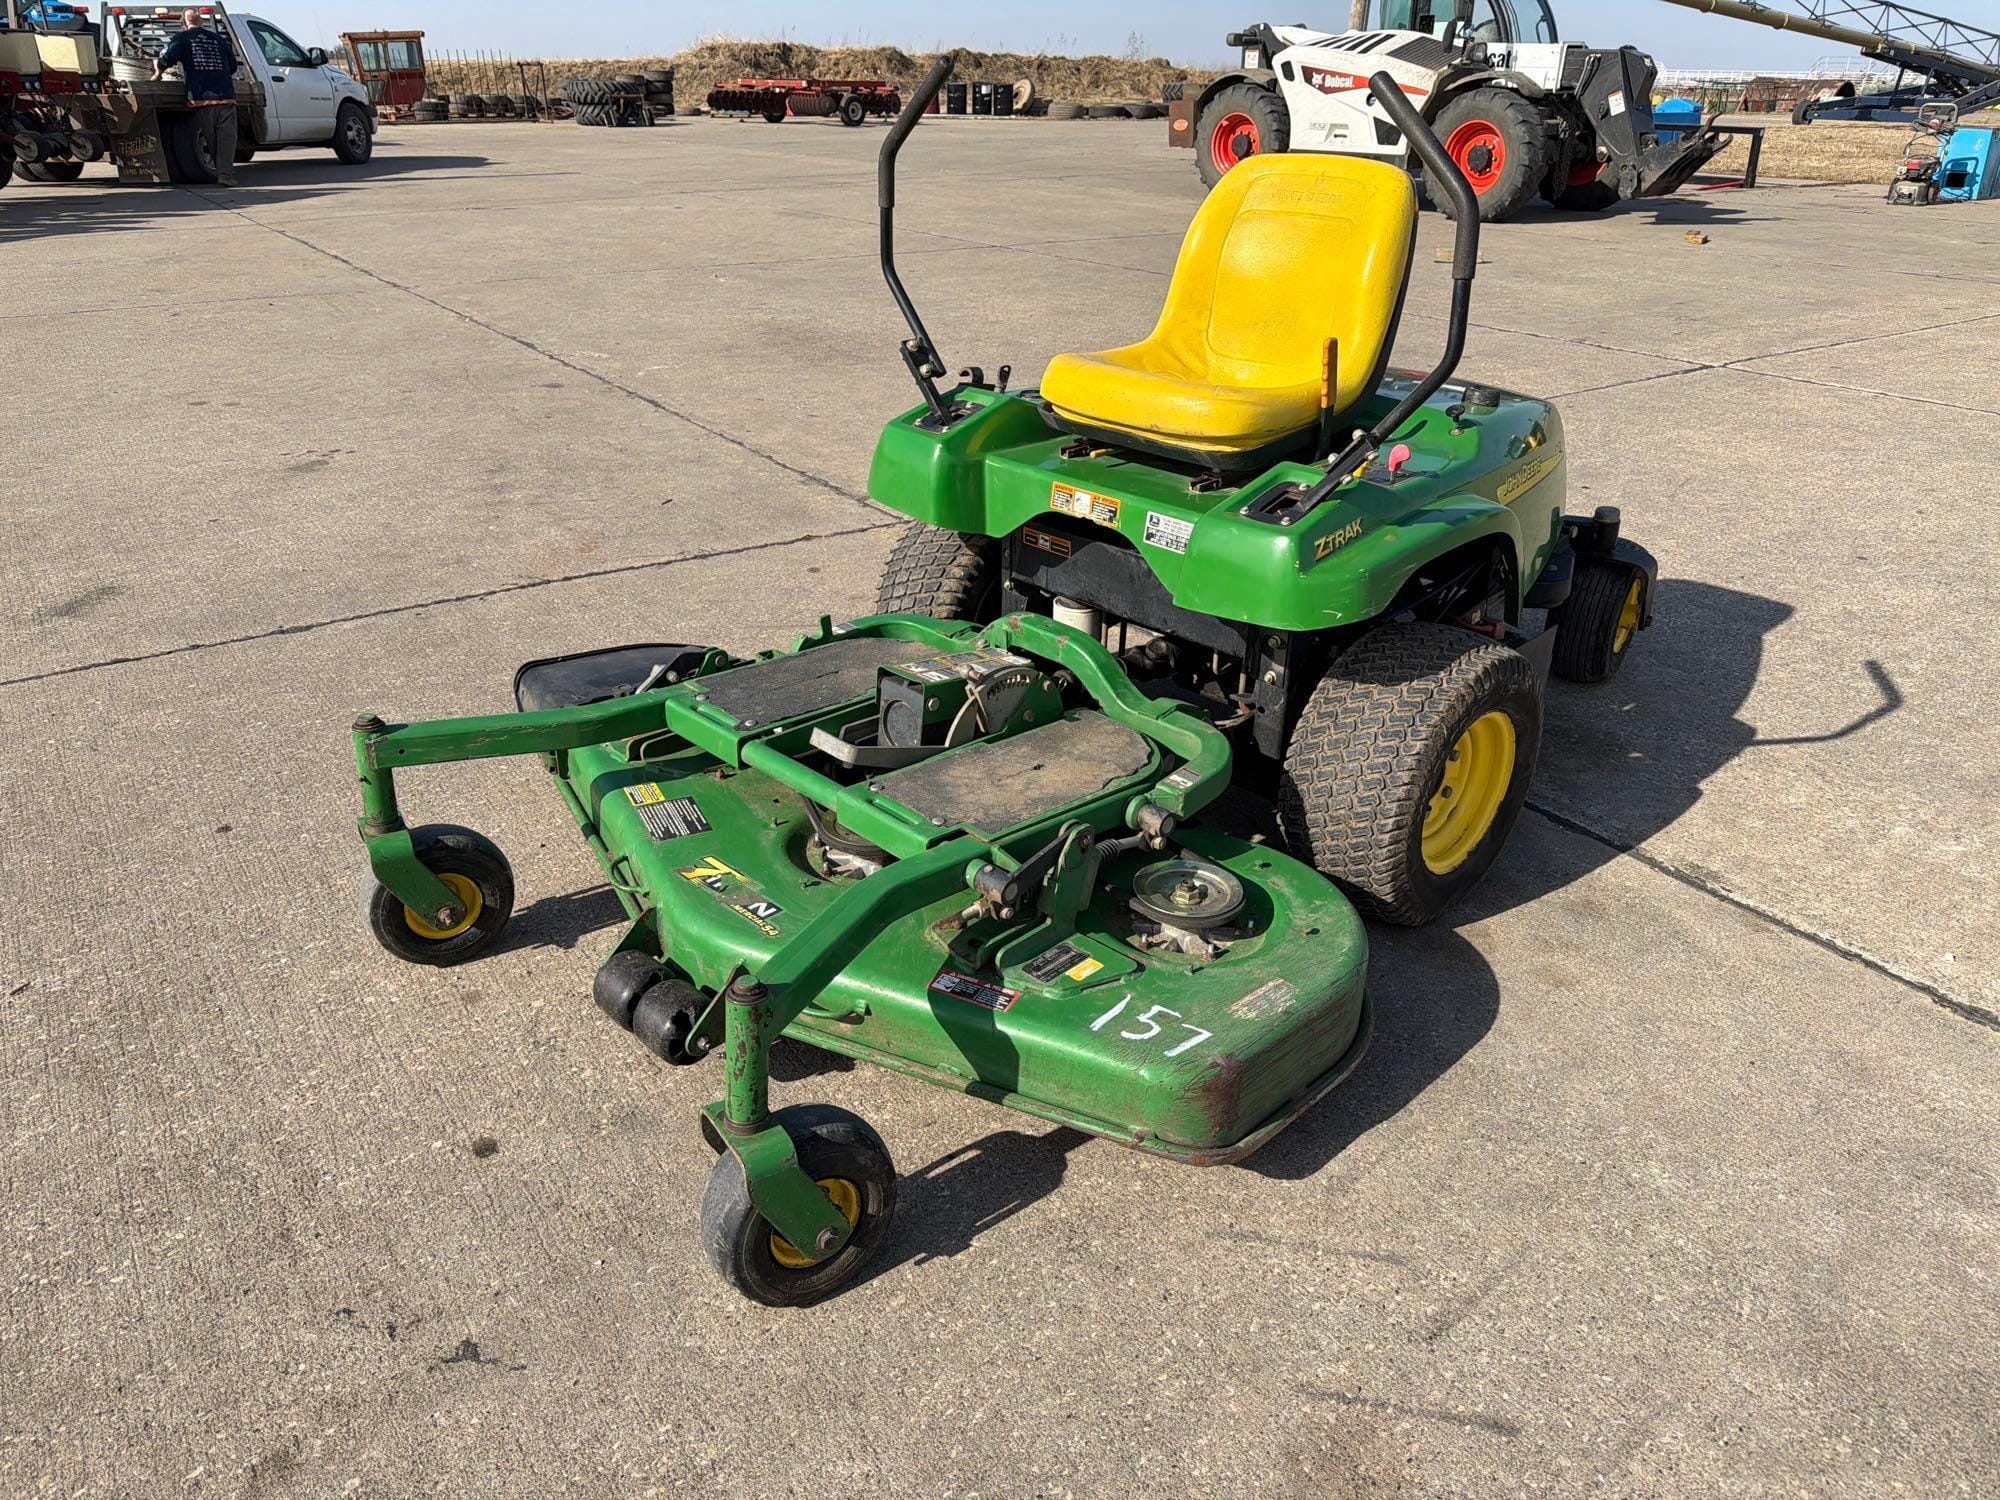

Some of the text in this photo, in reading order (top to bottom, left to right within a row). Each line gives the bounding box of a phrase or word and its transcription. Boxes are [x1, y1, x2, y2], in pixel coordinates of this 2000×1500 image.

[1488, 50, 1512, 69] cat
[1324, 74, 1354, 88] Bobcat
[1503, 456, 1542, 497] JOHN DEERE
[730, 904, 780, 937] MERCIAL 54
[1090, 993, 1214, 1057] 157
